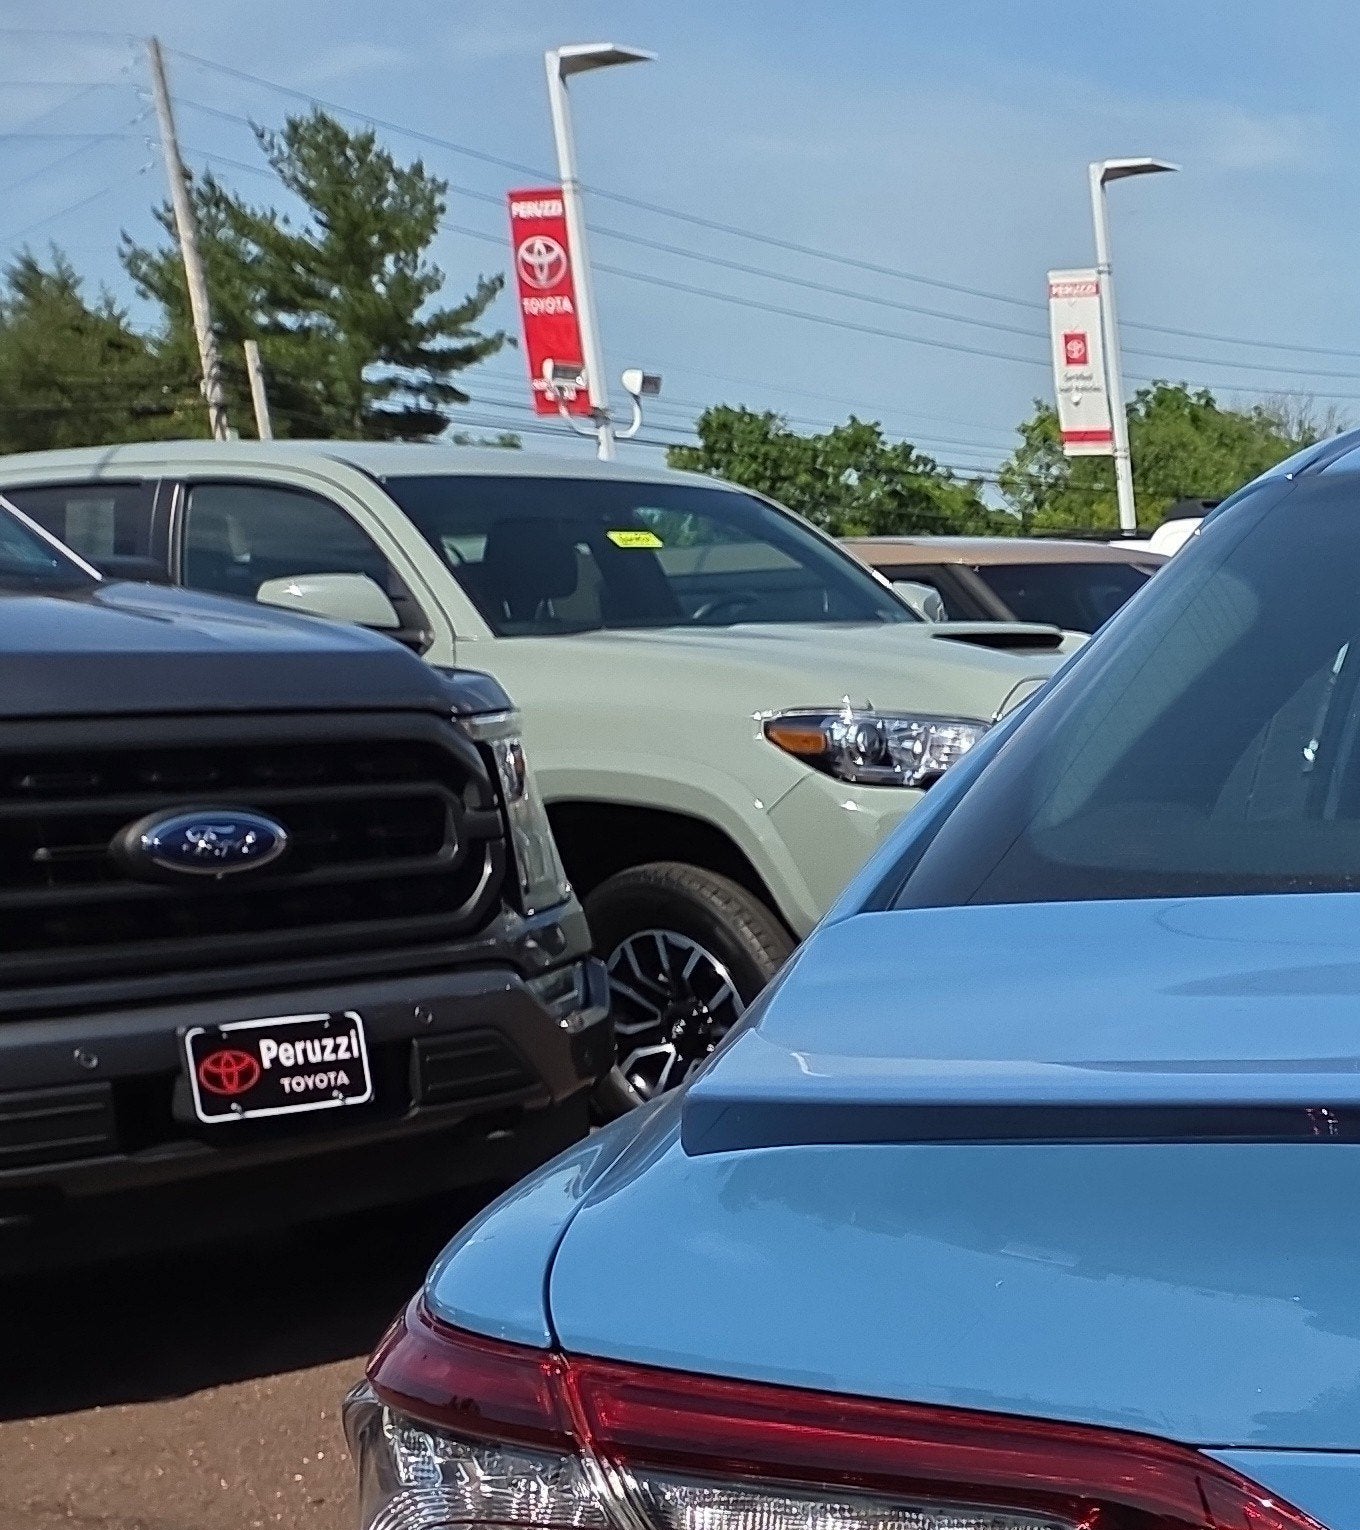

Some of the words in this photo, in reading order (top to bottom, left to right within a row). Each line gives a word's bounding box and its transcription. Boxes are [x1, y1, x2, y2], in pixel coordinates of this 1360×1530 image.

[522, 295, 574, 315] TOYOTA
[259, 1028, 360, 1069] Peruzzi
[280, 1069, 350, 1094] TOYOTA
